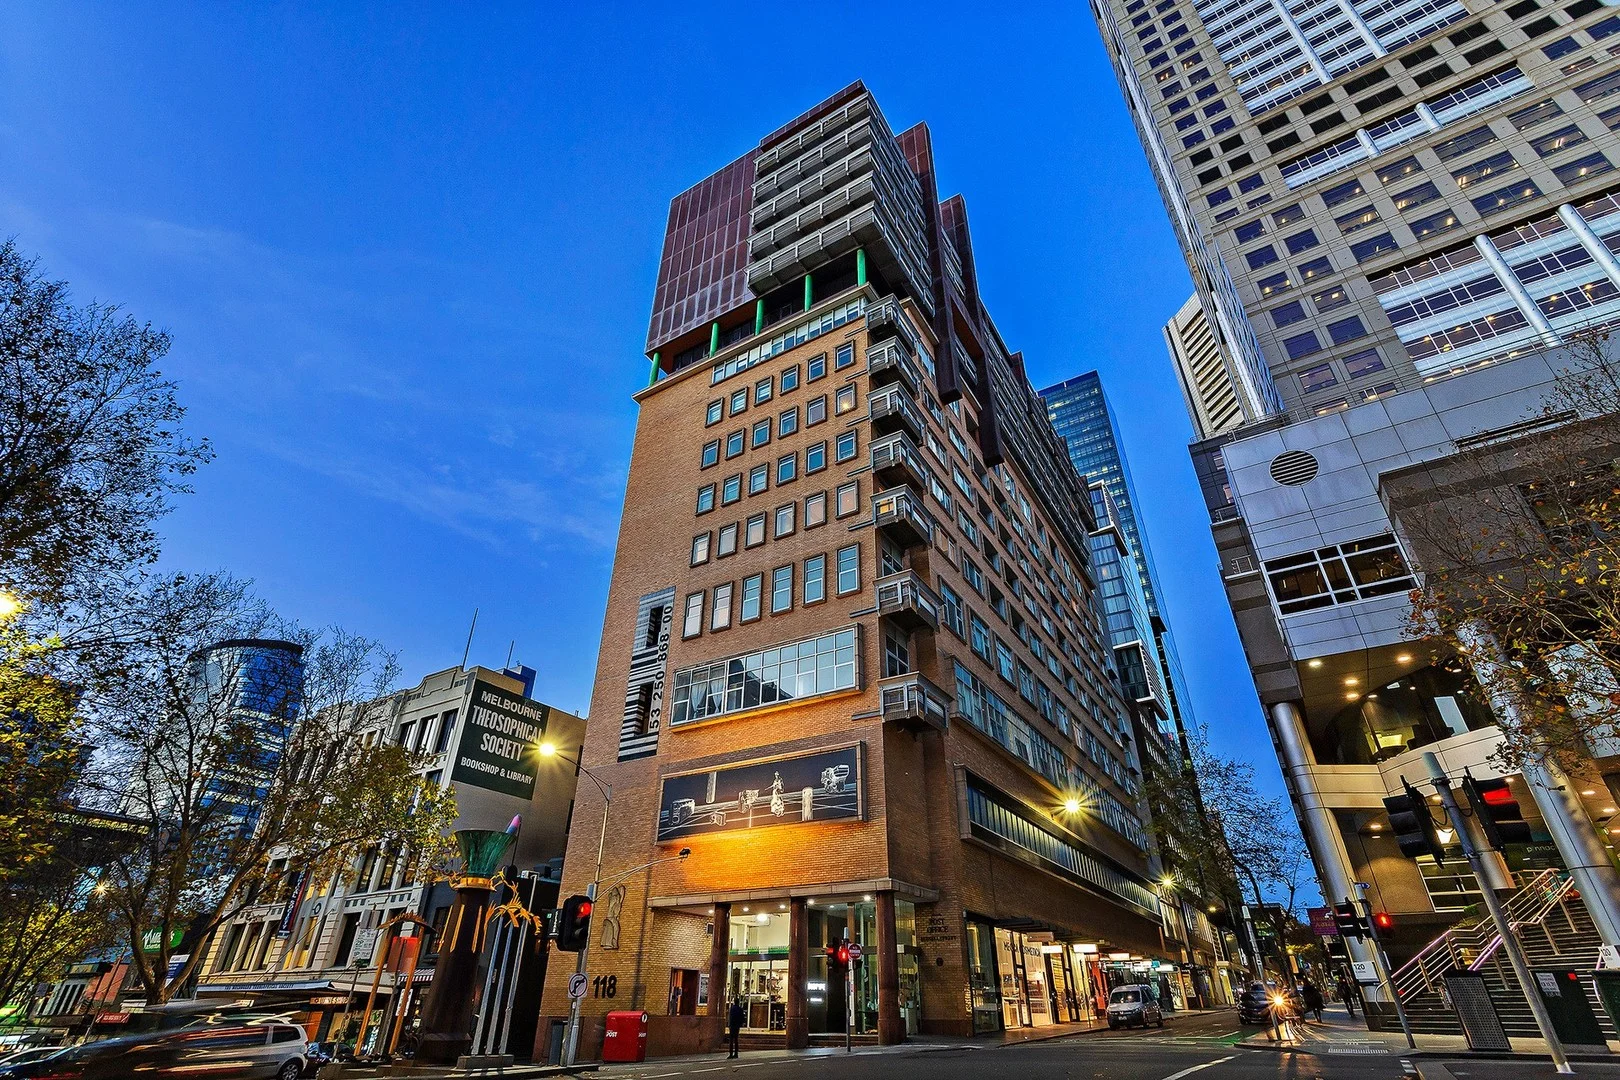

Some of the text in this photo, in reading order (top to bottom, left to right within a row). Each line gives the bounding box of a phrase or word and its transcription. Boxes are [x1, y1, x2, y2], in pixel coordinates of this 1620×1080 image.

[653, 670, 665, 701] 250
[481, 690, 542, 722] MELBOURNE
[649, 707, 661, 729] 53
[471, 705, 542, 743] THEOSOPHICAL
[480, 732, 525, 761] SOCIETY
[460, 756, 534, 785] BOOKSHOP & LIBRARY
[1353, 963, 1366, 971] 120
[592, 975, 618, 999] 118
